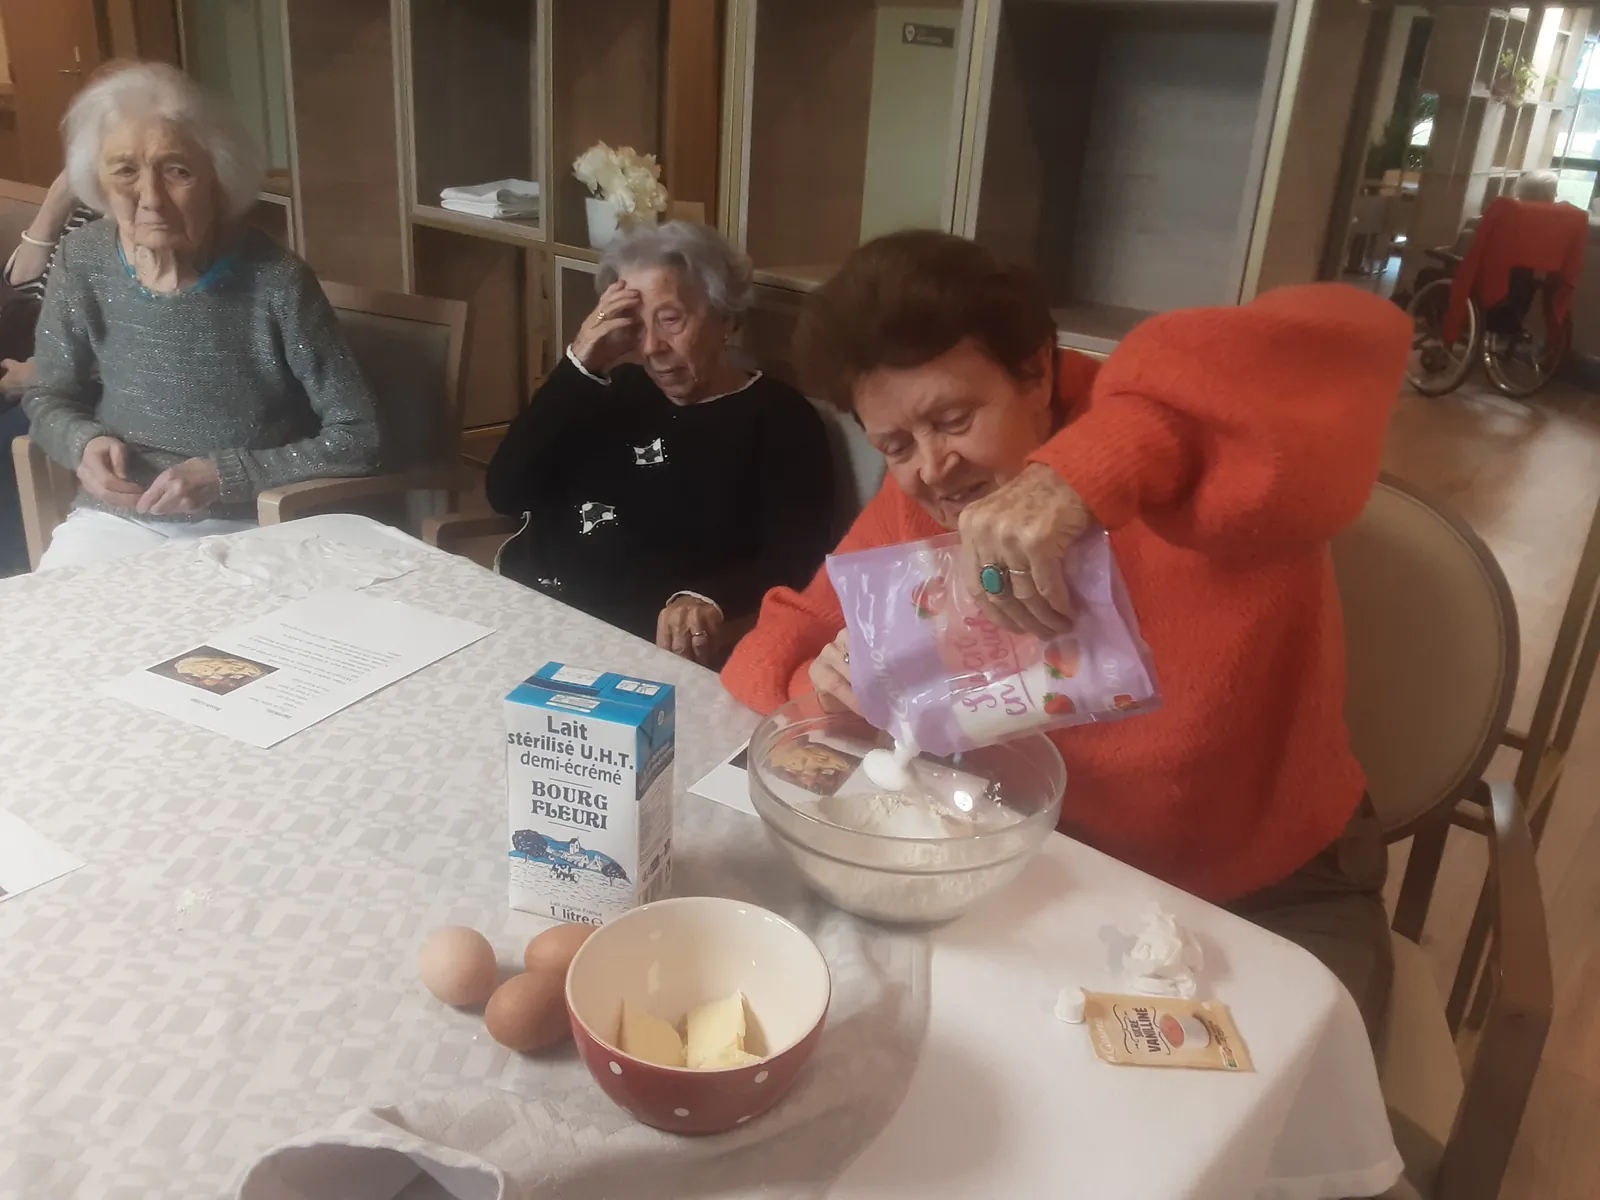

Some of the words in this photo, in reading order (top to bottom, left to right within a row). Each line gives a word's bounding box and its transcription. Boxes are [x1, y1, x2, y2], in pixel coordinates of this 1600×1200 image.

[1000, 683, 1028, 715] en
[547, 715, 588, 741] Lait
[507, 732, 575, 756] stérilisé
[580, 743, 634, 770] U.H.T.
[520, 751, 622, 785] demi-écrémé
[531, 780, 608, 811] BOURG
[531, 799, 608, 830] FLEURI
[550, 906, 556, 916] 1
[562, 908, 590, 925] litre
[1129, 1019, 1144, 1038] SUCRE
[1132, 1007, 1161, 1053] VANILLINÉ
